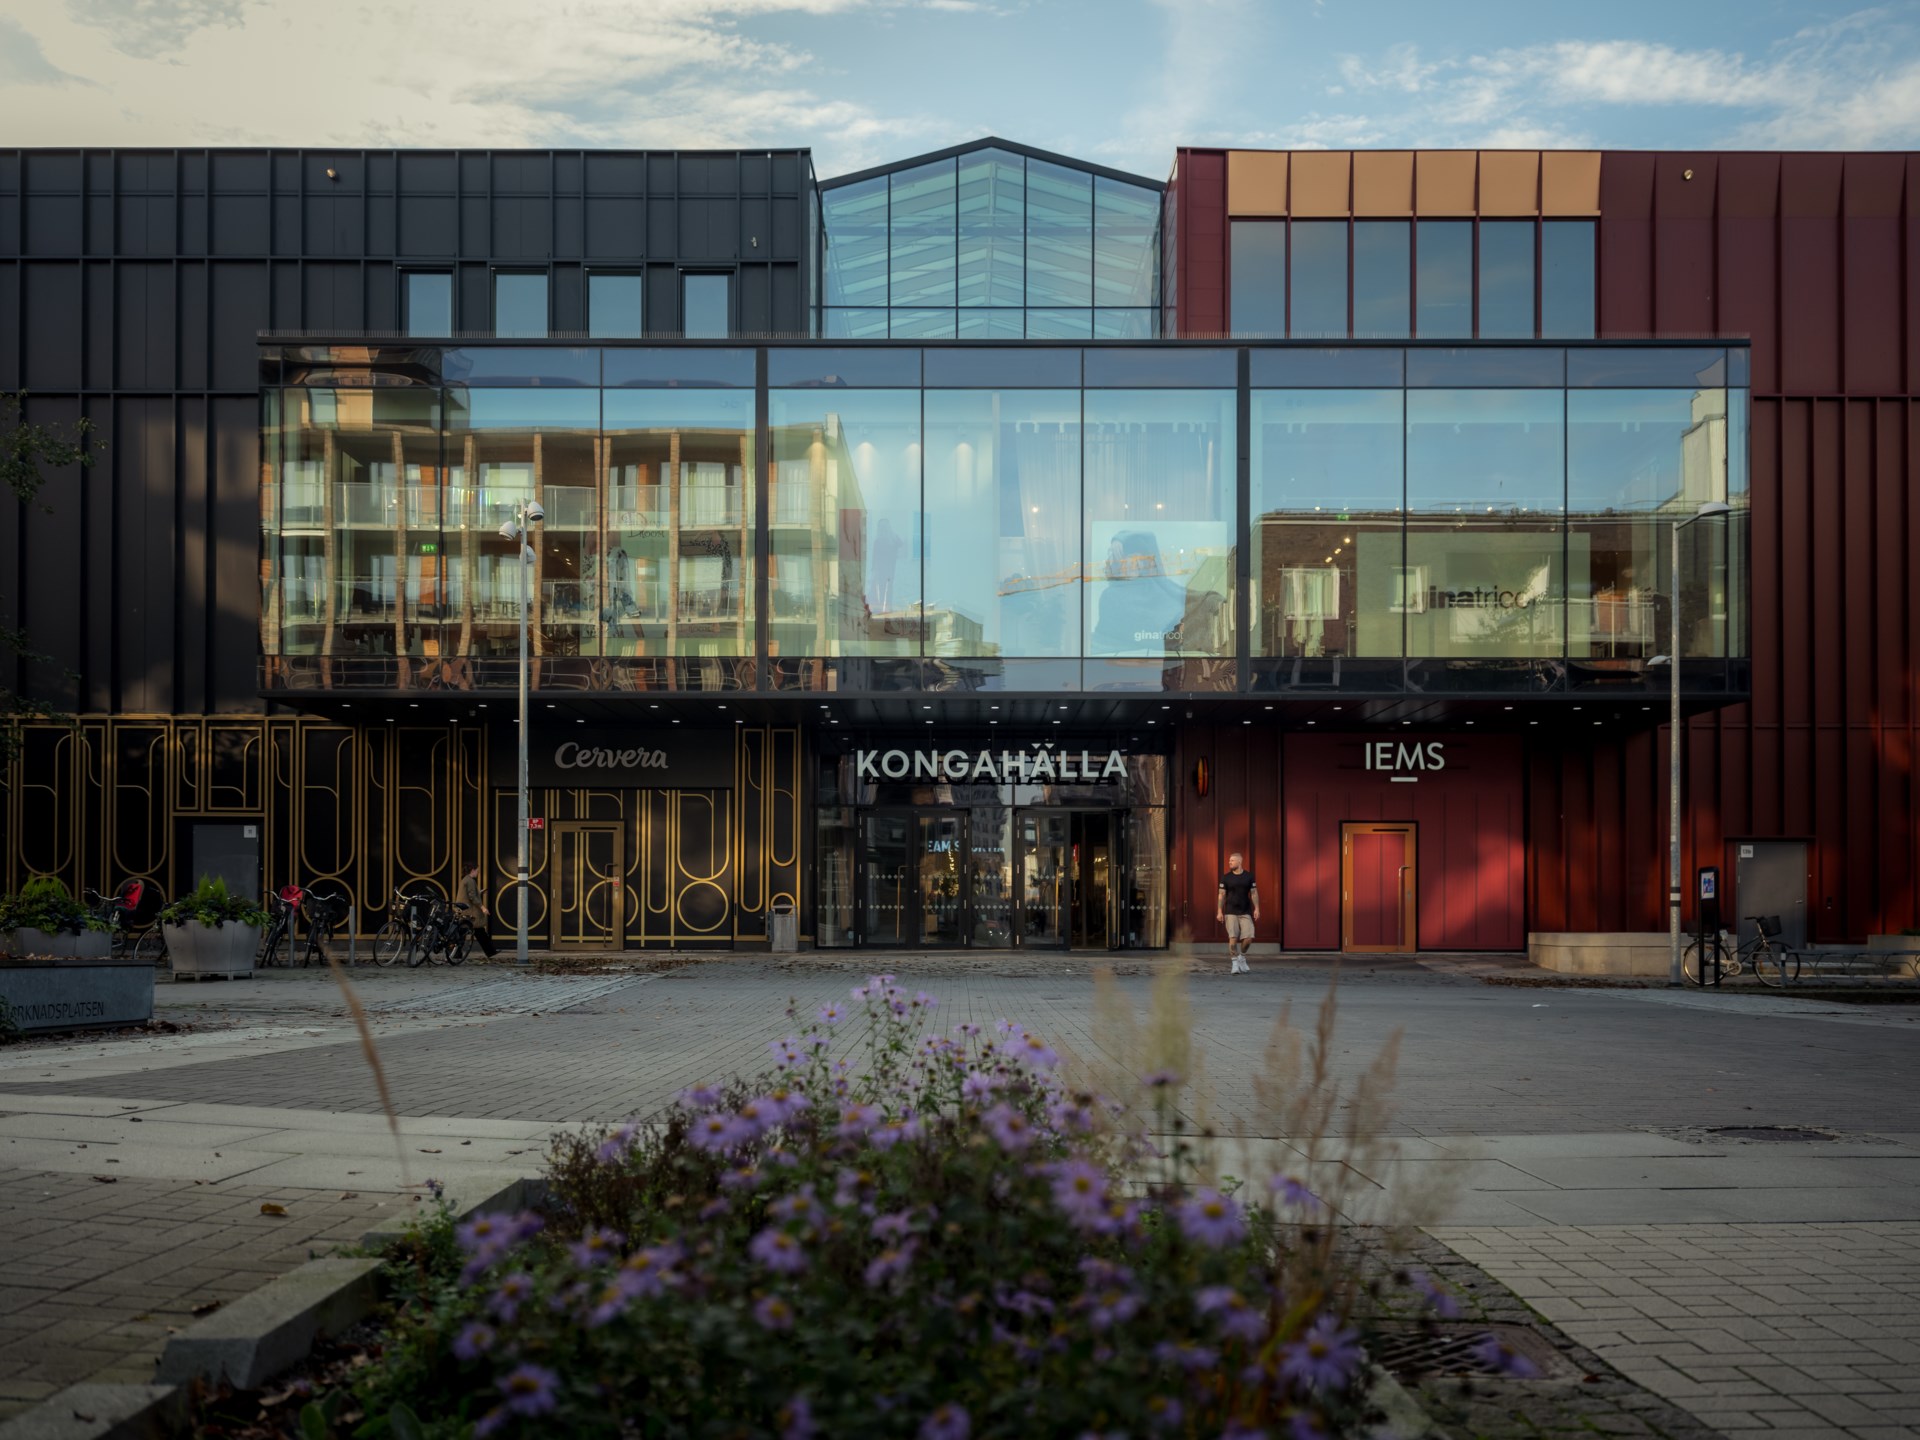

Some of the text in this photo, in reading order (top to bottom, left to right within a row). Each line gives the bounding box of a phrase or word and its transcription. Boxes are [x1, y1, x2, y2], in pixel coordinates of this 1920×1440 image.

[554, 741, 670, 769] Cervera
[857, 743, 1129, 778] KONGAHÄLLA
[1365, 741, 1446, 771] IEMS
[927, 840, 951, 853] EAM
[10, 1001, 105, 1022] ARKNADSPLATSEN
